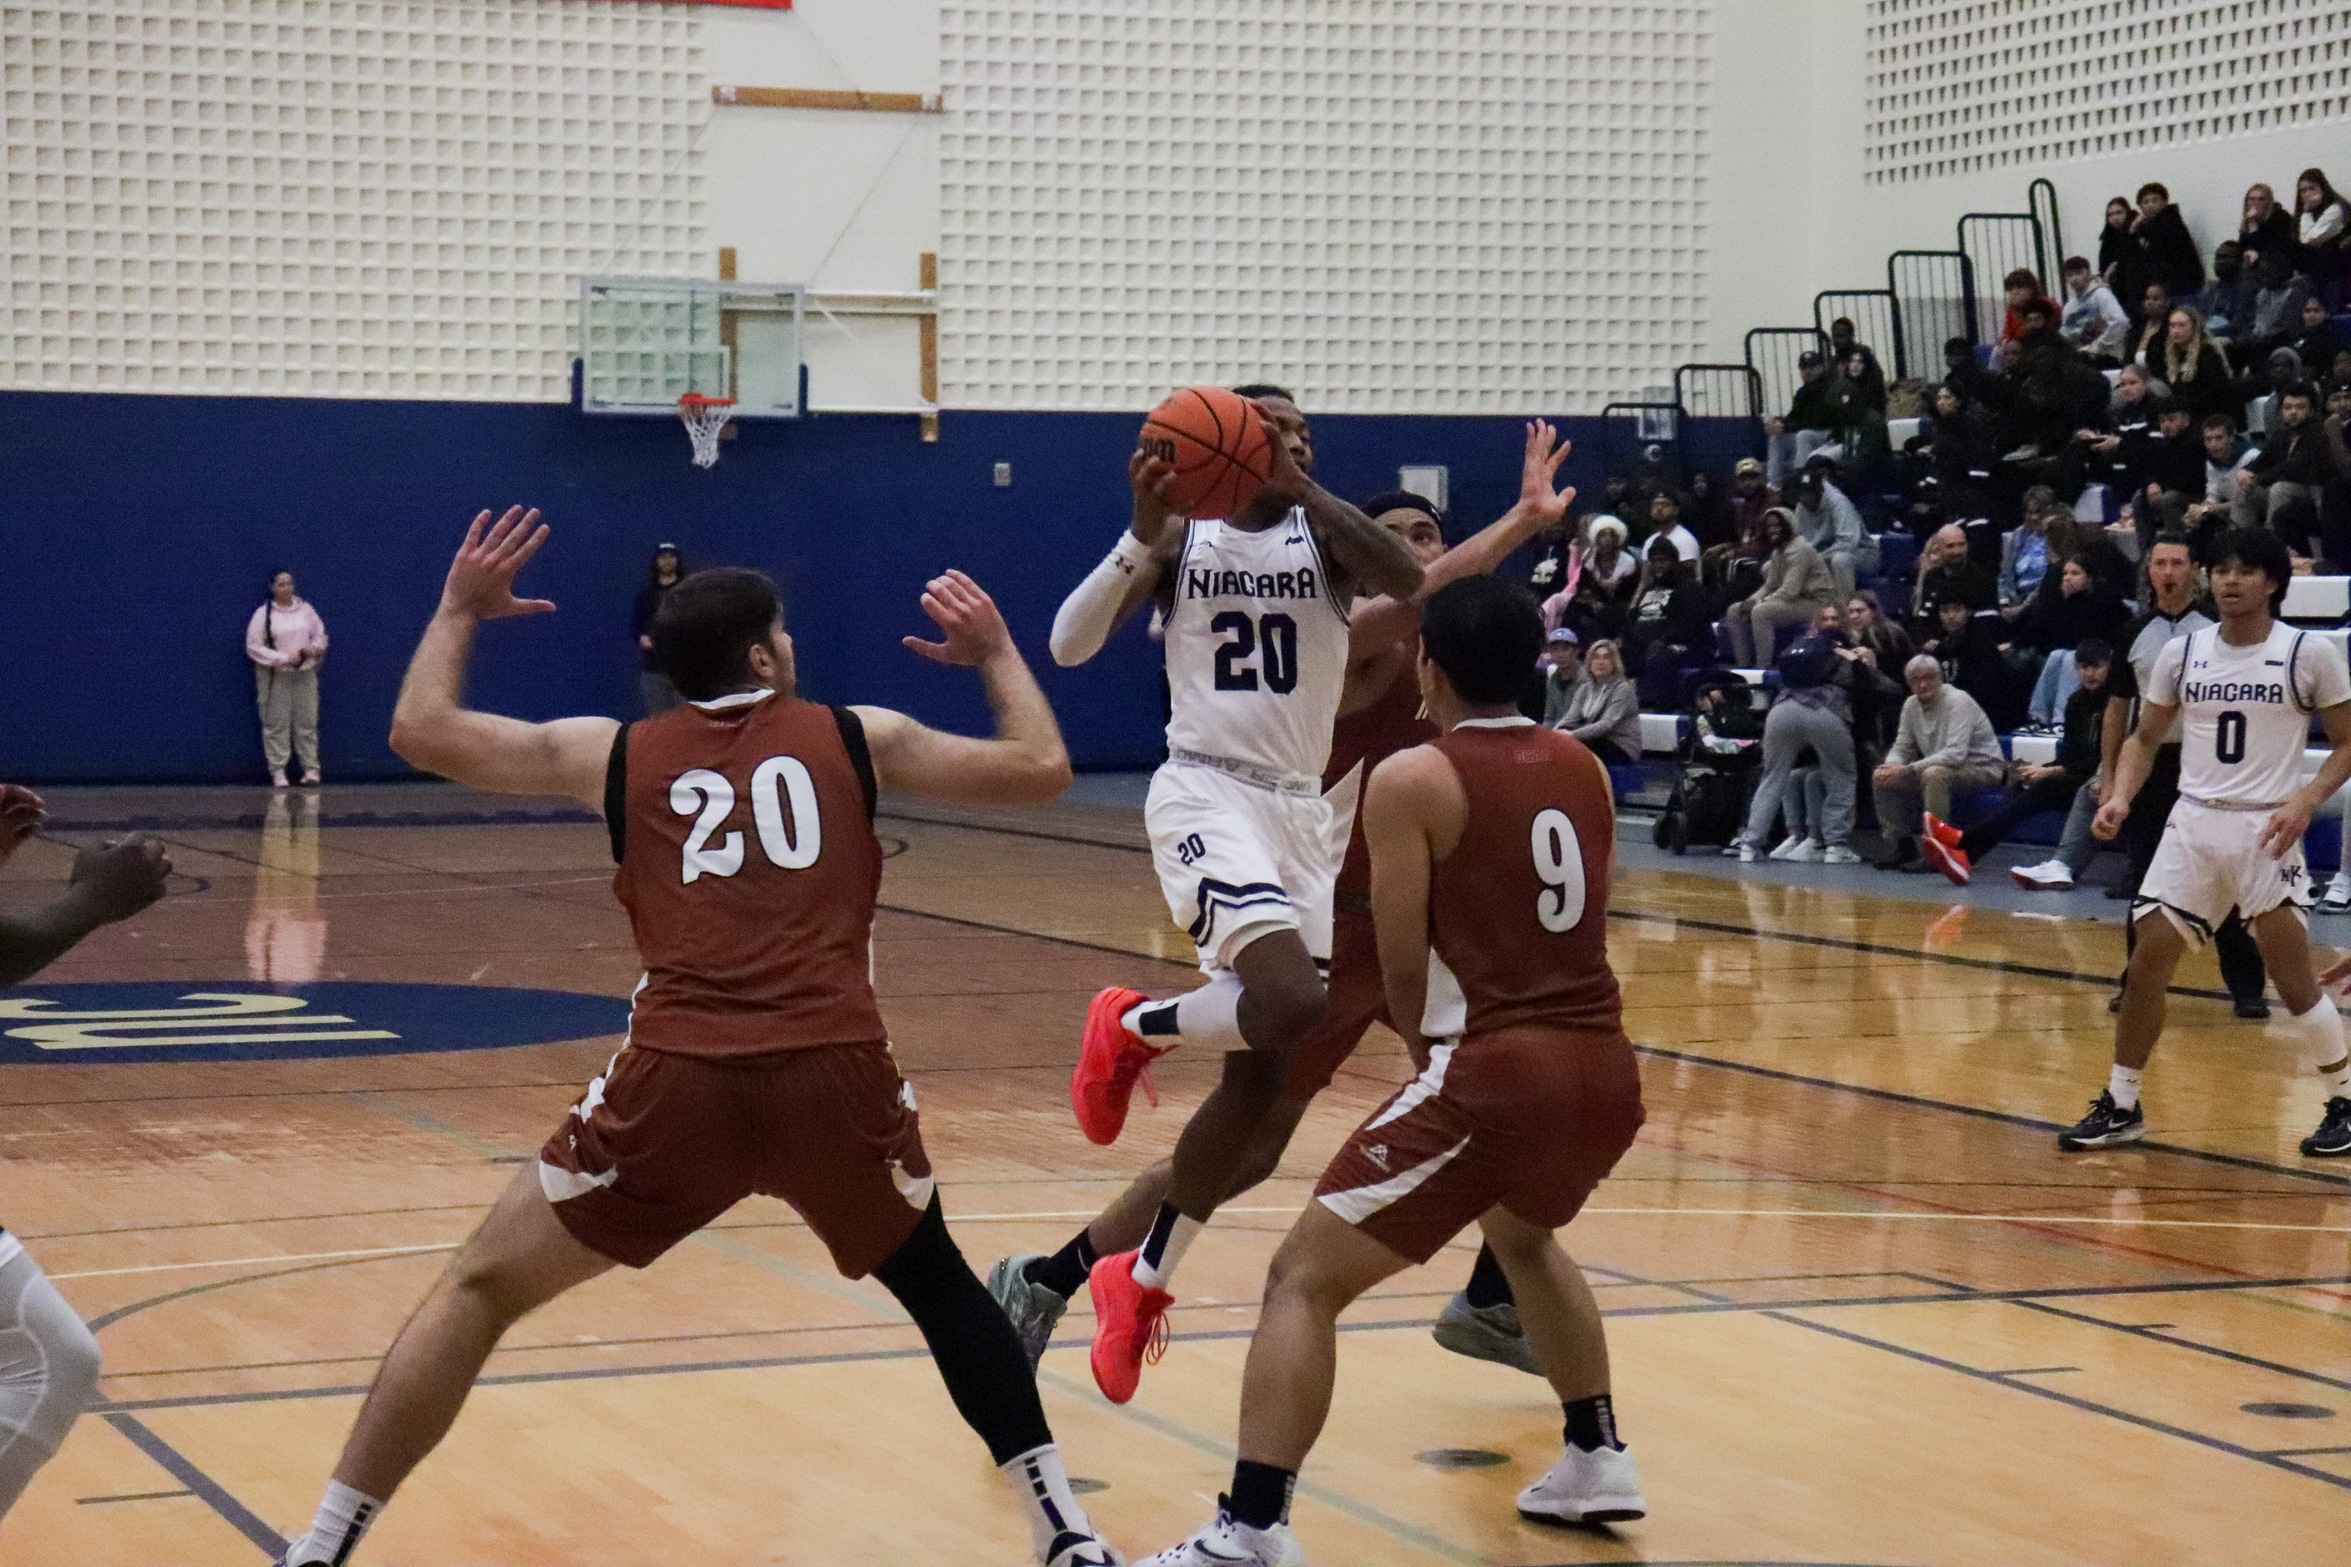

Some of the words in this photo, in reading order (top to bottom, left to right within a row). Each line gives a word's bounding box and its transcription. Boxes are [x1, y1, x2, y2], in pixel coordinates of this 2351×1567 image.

[1187, 566, 1317, 600] NIAGARA
[1210, 611, 1298, 695] 20
[2185, 682, 2284, 704] NIAGARA
[2216, 711, 2247, 764] 0
[669, 754, 822, 885] 20
[1177, 832, 1207, 867] 20
[1530, 807, 1587, 934] 9
